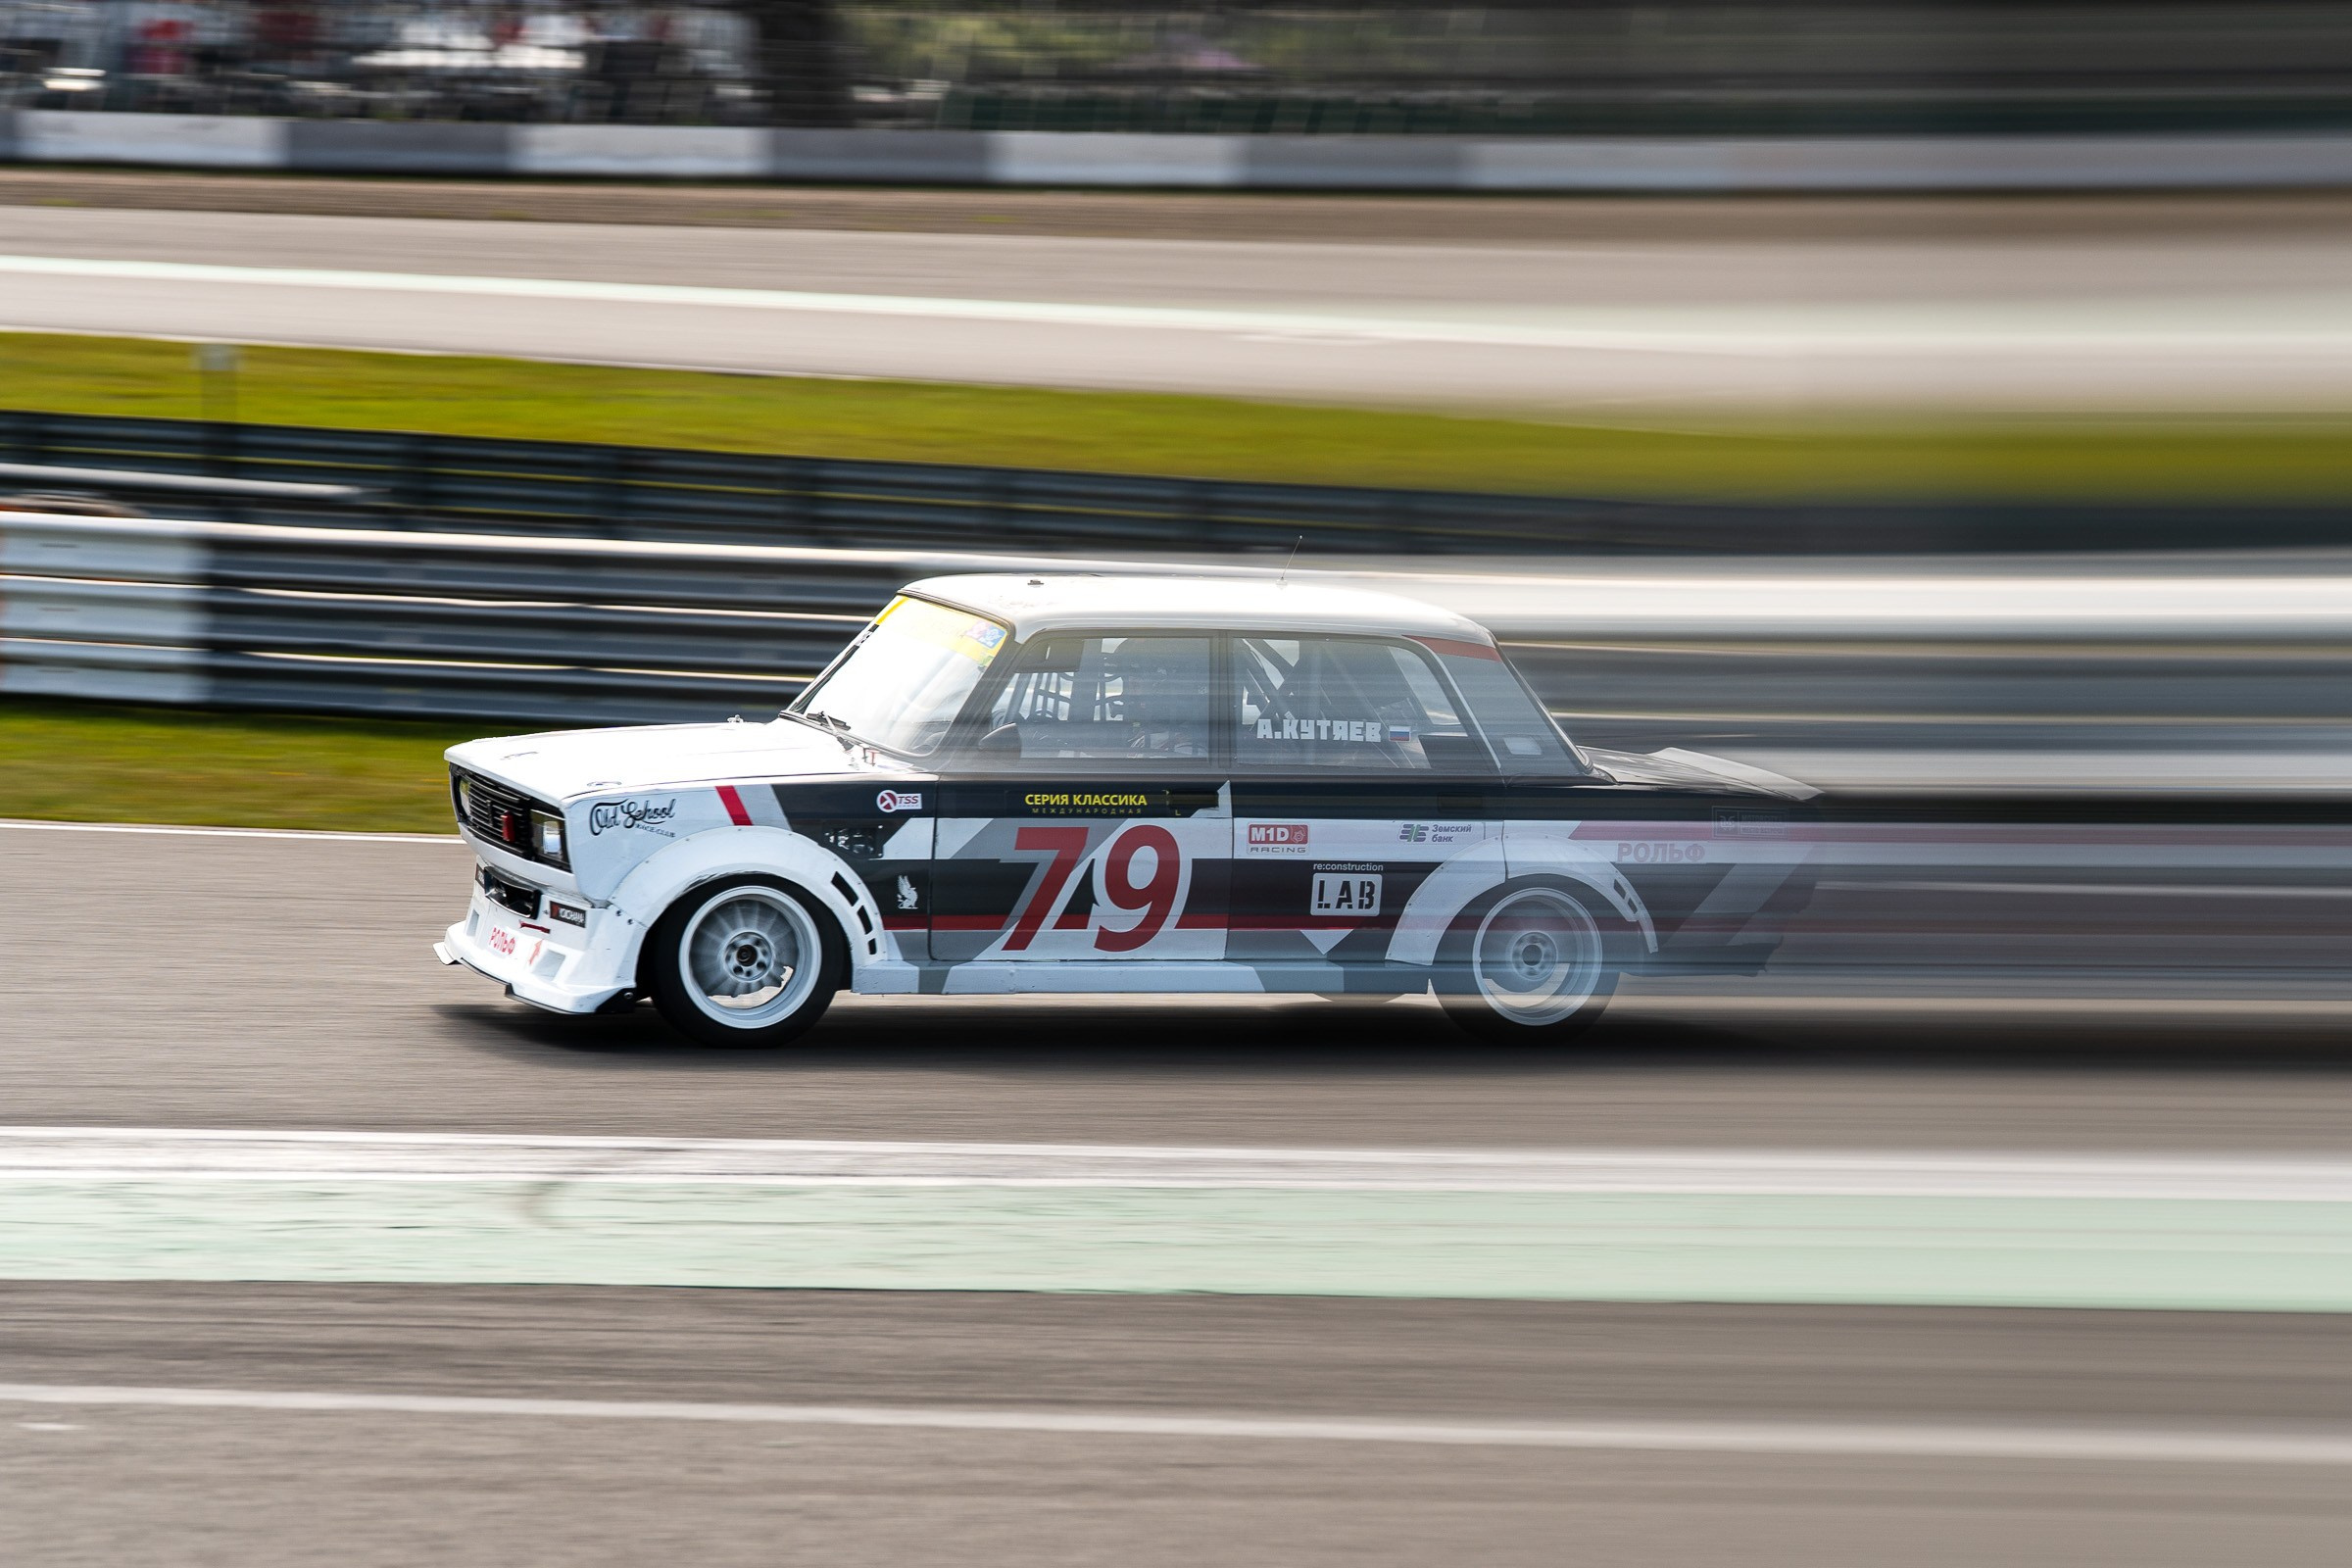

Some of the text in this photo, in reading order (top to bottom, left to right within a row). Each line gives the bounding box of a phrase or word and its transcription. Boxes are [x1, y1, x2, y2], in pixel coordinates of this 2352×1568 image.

[1025, 794, 1148, 806] СЕРИЯ КЛАССИКА
[589, 799, 676, 836] Old School
[1250, 827, 1290, 842] M1D
[1432, 824, 1472, 834] Земский
[1432, 833, 1453, 843] банк
[1617, 843, 1706, 863] РОЛЬФ
[1313, 862, 1384, 871] re:construction
[1001, 824, 1181, 952] 79
[1317, 880, 1376, 909] LAB
